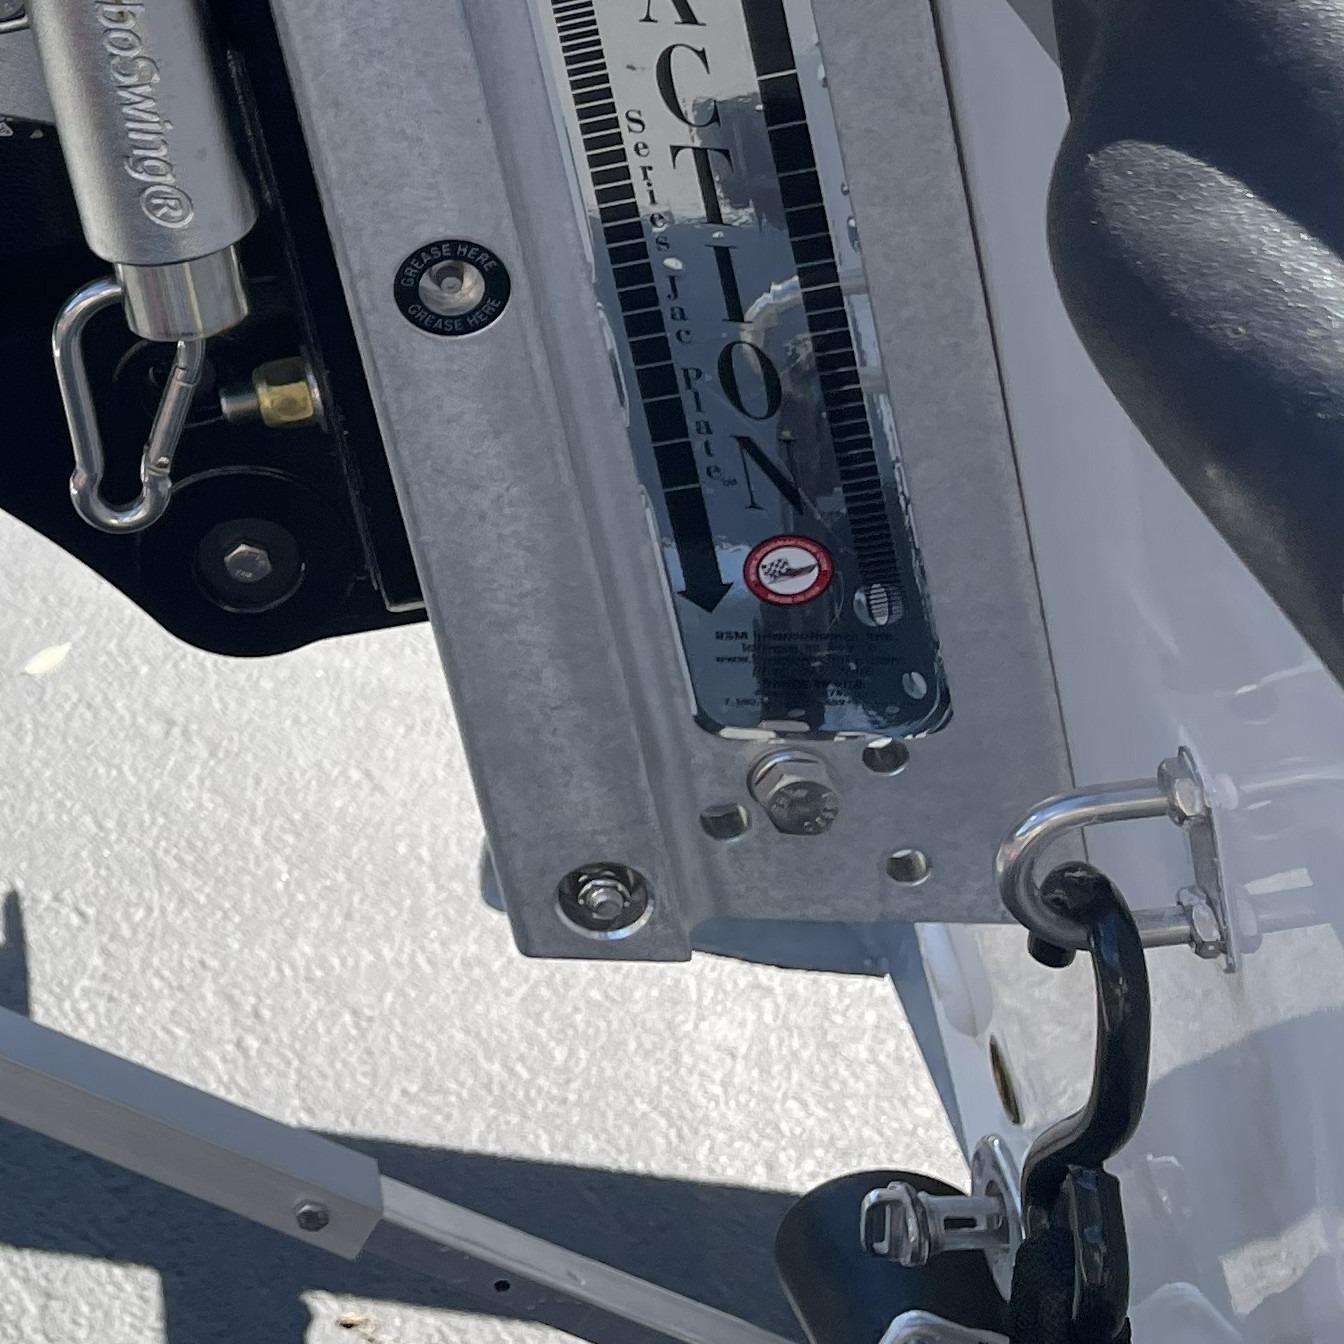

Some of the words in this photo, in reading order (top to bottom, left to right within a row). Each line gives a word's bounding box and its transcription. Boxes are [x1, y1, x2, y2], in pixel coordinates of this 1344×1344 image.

[400, 243, 452, 287] GREASE
[456, 243, 497, 272] HERE
[407, 304, 465, 332] GREASE
[466, 297, 501, 327] HERE
[666, 274, 695, 345] Jac
